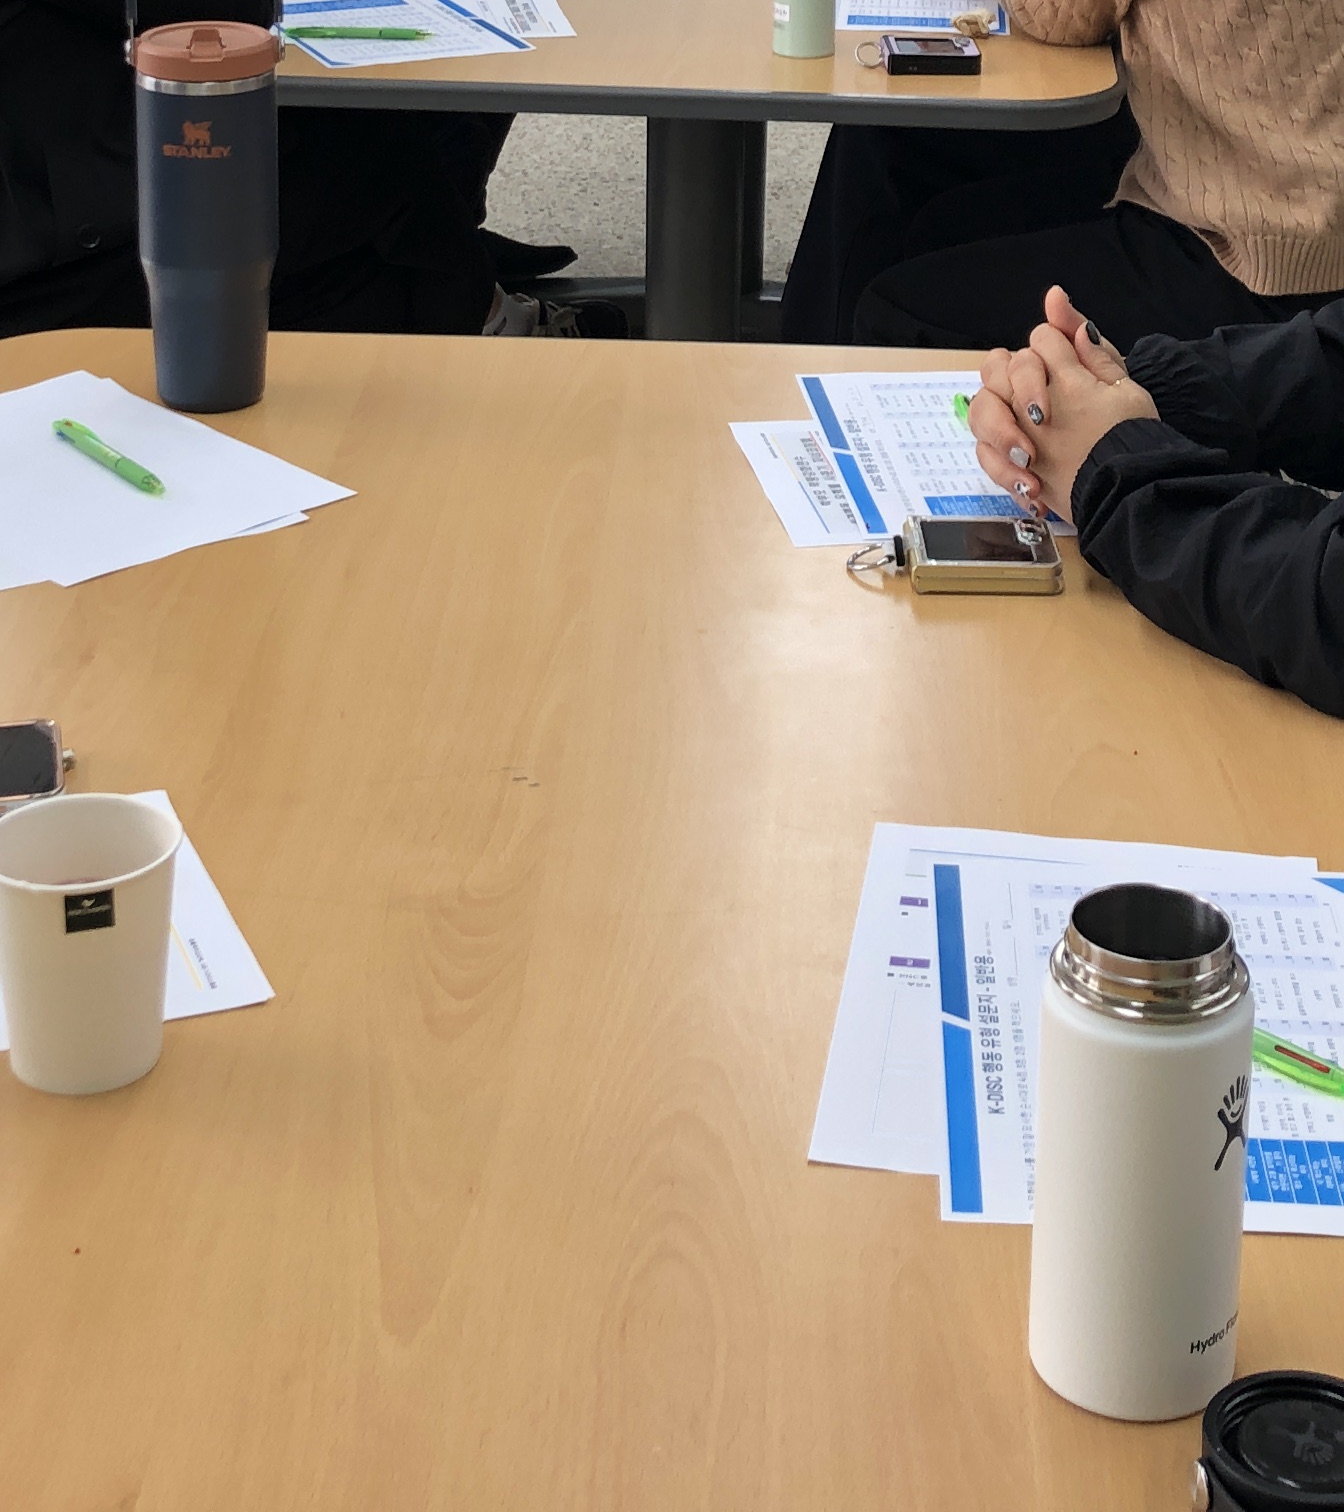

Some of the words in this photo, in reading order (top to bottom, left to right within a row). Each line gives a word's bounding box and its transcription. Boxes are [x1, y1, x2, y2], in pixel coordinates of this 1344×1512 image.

[162, 144, 232, 159] STANLEY
[973, 955, 996, 985] 일반용
[976, 994, 999, 1025] 설문지
[979, 1027, 1001, 1049] 유형
[981, 1051, 1004, 1073] 행동
[985, 1075, 1005, 1115] K-DISC
[1189, 1328, 1224, 1355] Hydro
